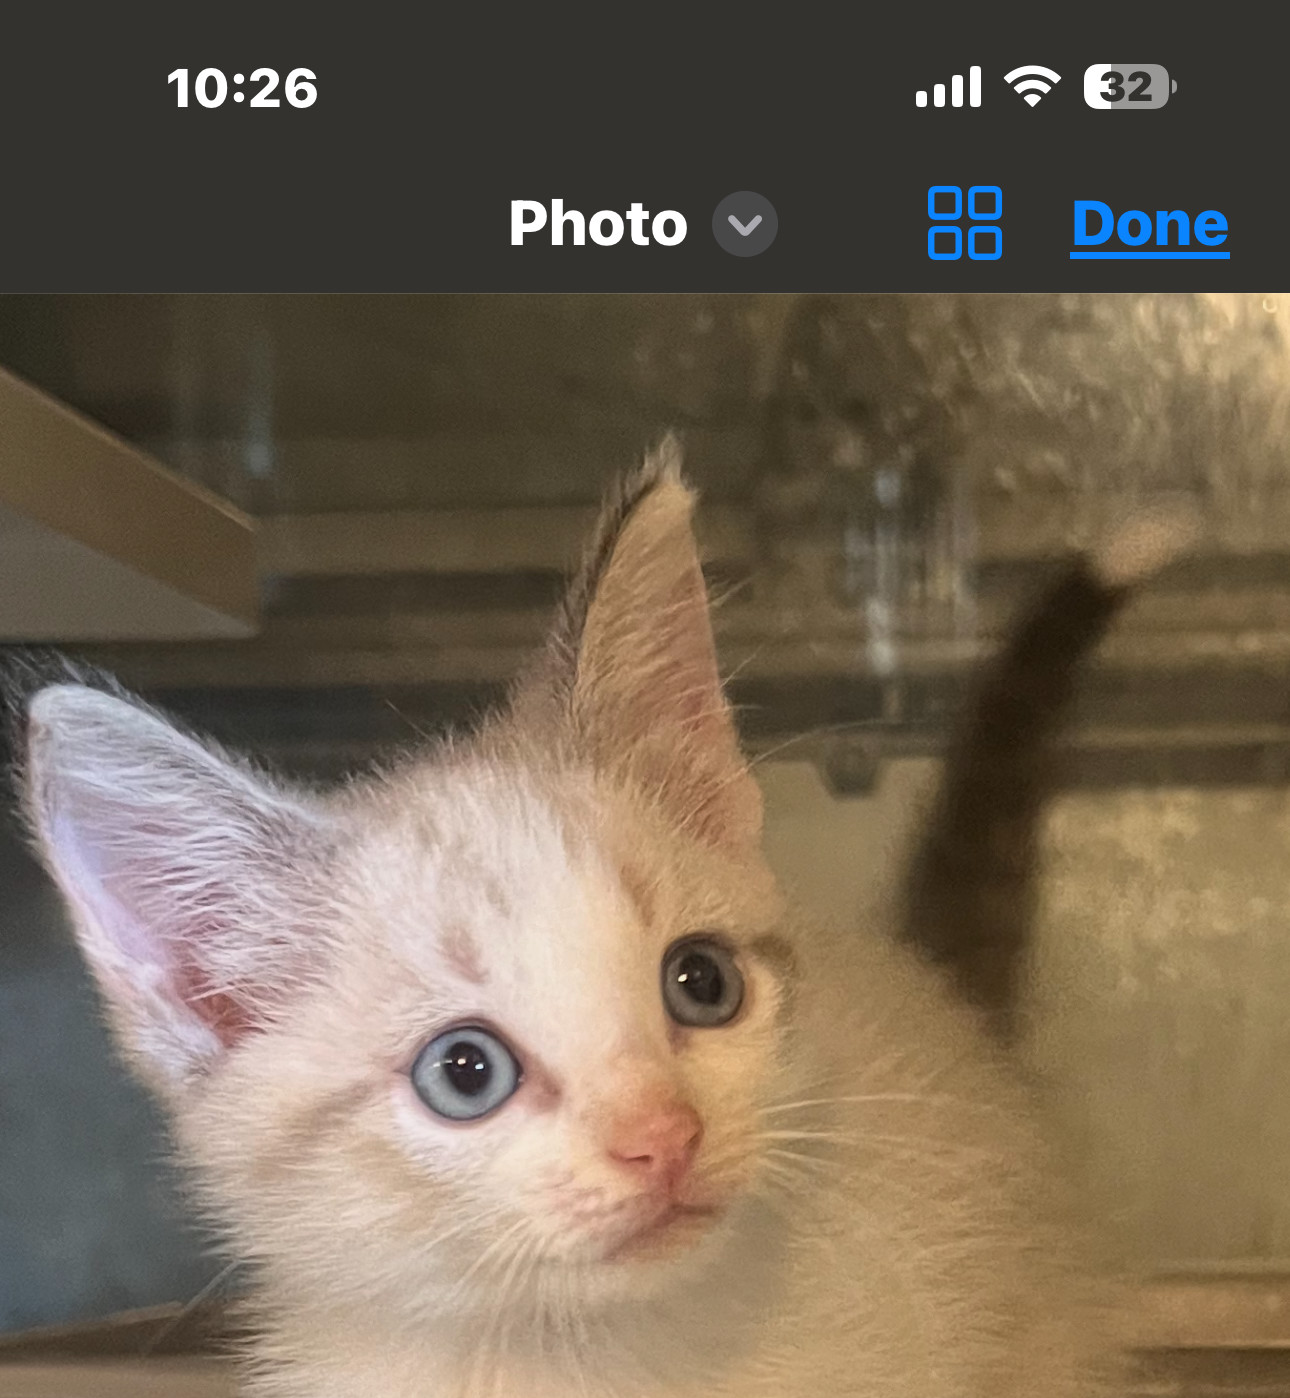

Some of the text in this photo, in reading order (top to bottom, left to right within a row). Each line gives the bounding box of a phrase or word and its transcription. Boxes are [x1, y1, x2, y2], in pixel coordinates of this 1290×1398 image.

[168, 68, 317, 108] 10:26
[1099, 70, 1153, 103] 32
[511, 199, 687, 246] Photo
[1072, 200, 1230, 247] Done
